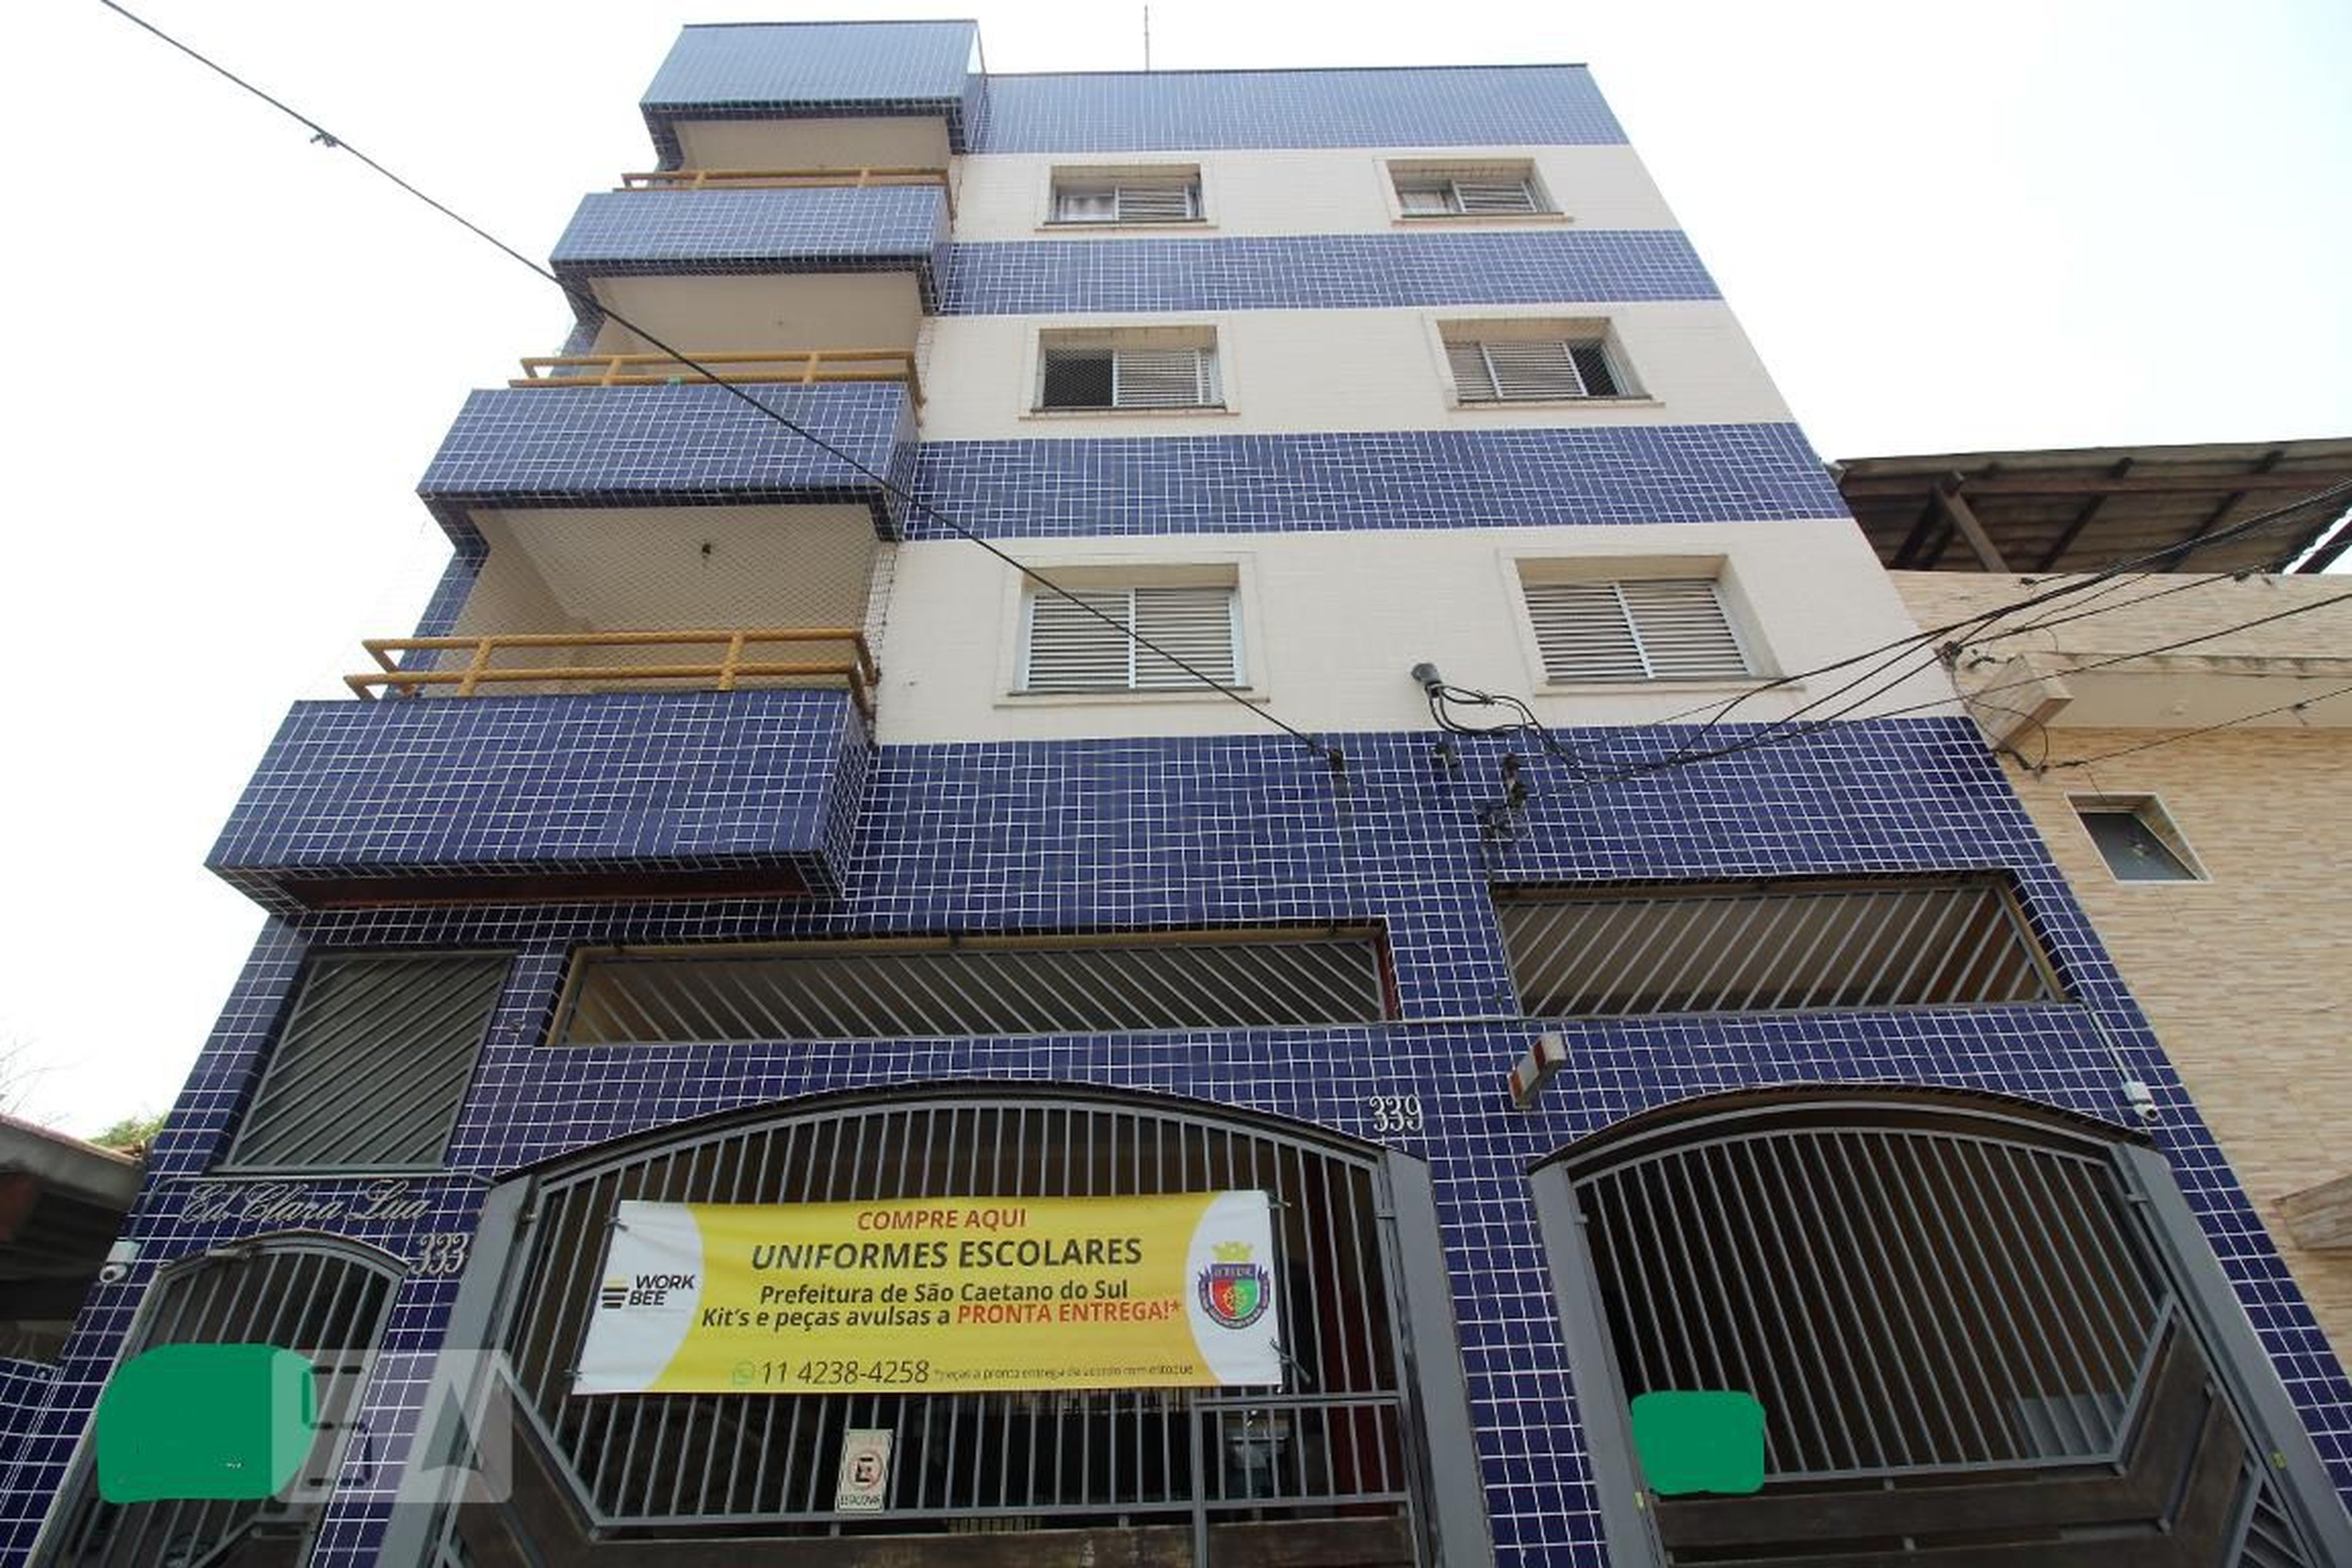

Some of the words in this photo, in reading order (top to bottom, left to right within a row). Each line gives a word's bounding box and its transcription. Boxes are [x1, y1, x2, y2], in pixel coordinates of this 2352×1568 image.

[1370, 1094, 1423, 1132] 339
[241, 1182, 344, 1222] Clara
[858, 1210, 958, 1231] COMPRE
[964, 1208, 1026, 1231] AQUI
[409, 1232, 469, 1275] 333
[752, 1241, 948, 1270] UNIFORMES
[959, 1238, 1142, 1268] ESCOLARES
[636, 1274, 695, 1289] WORK
[761, 1284, 873, 1305] Prefeitura
[881, 1283, 908, 1303] de
[914, 1283, 954, 1303] São
[960, 1283, 1054, 1302] Caetano
[1060, 1280, 1088, 1300] do
[1094, 1280, 1128, 1300] Sul
[629, 1290, 668, 1306] BEE
[756, 1311, 769, 1327] e
[774, 1310, 840, 1332] peças
[846, 1306, 931, 1326] avulsas
[937, 1310, 951, 1325] a
[957, 1304, 1052, 1324] PRONTA
[762, 1361, 787, 1384] 11
[797, 1359, 930, 1384] 4238-4258
